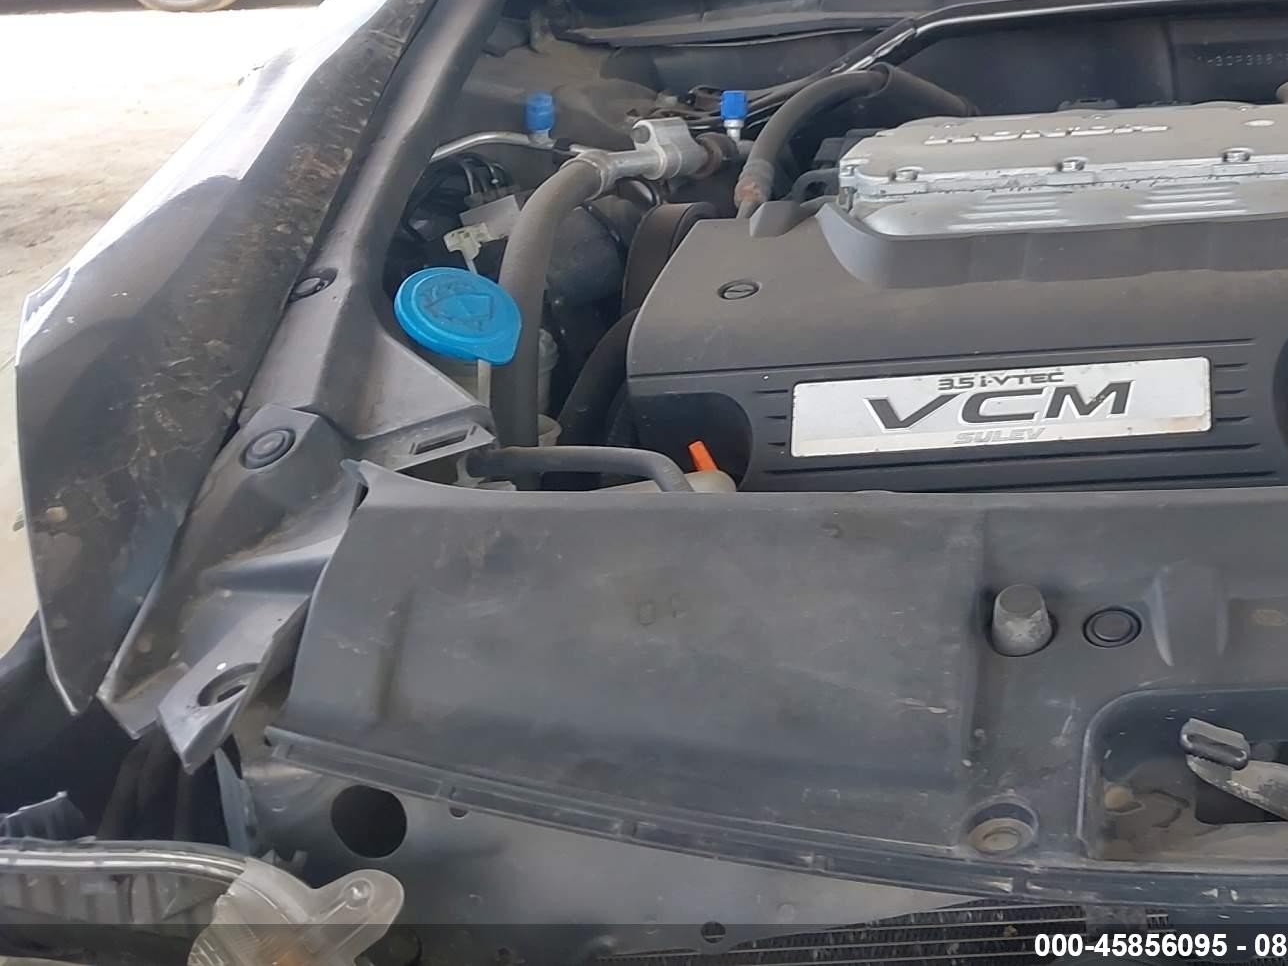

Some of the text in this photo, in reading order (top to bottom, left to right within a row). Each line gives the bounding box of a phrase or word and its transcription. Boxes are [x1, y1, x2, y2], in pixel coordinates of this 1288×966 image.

[980, 371, 1064, 387] i-VTEC
[866, 380, 1135, 431] VCM
[953, 427, 1045, 445] SULEV
